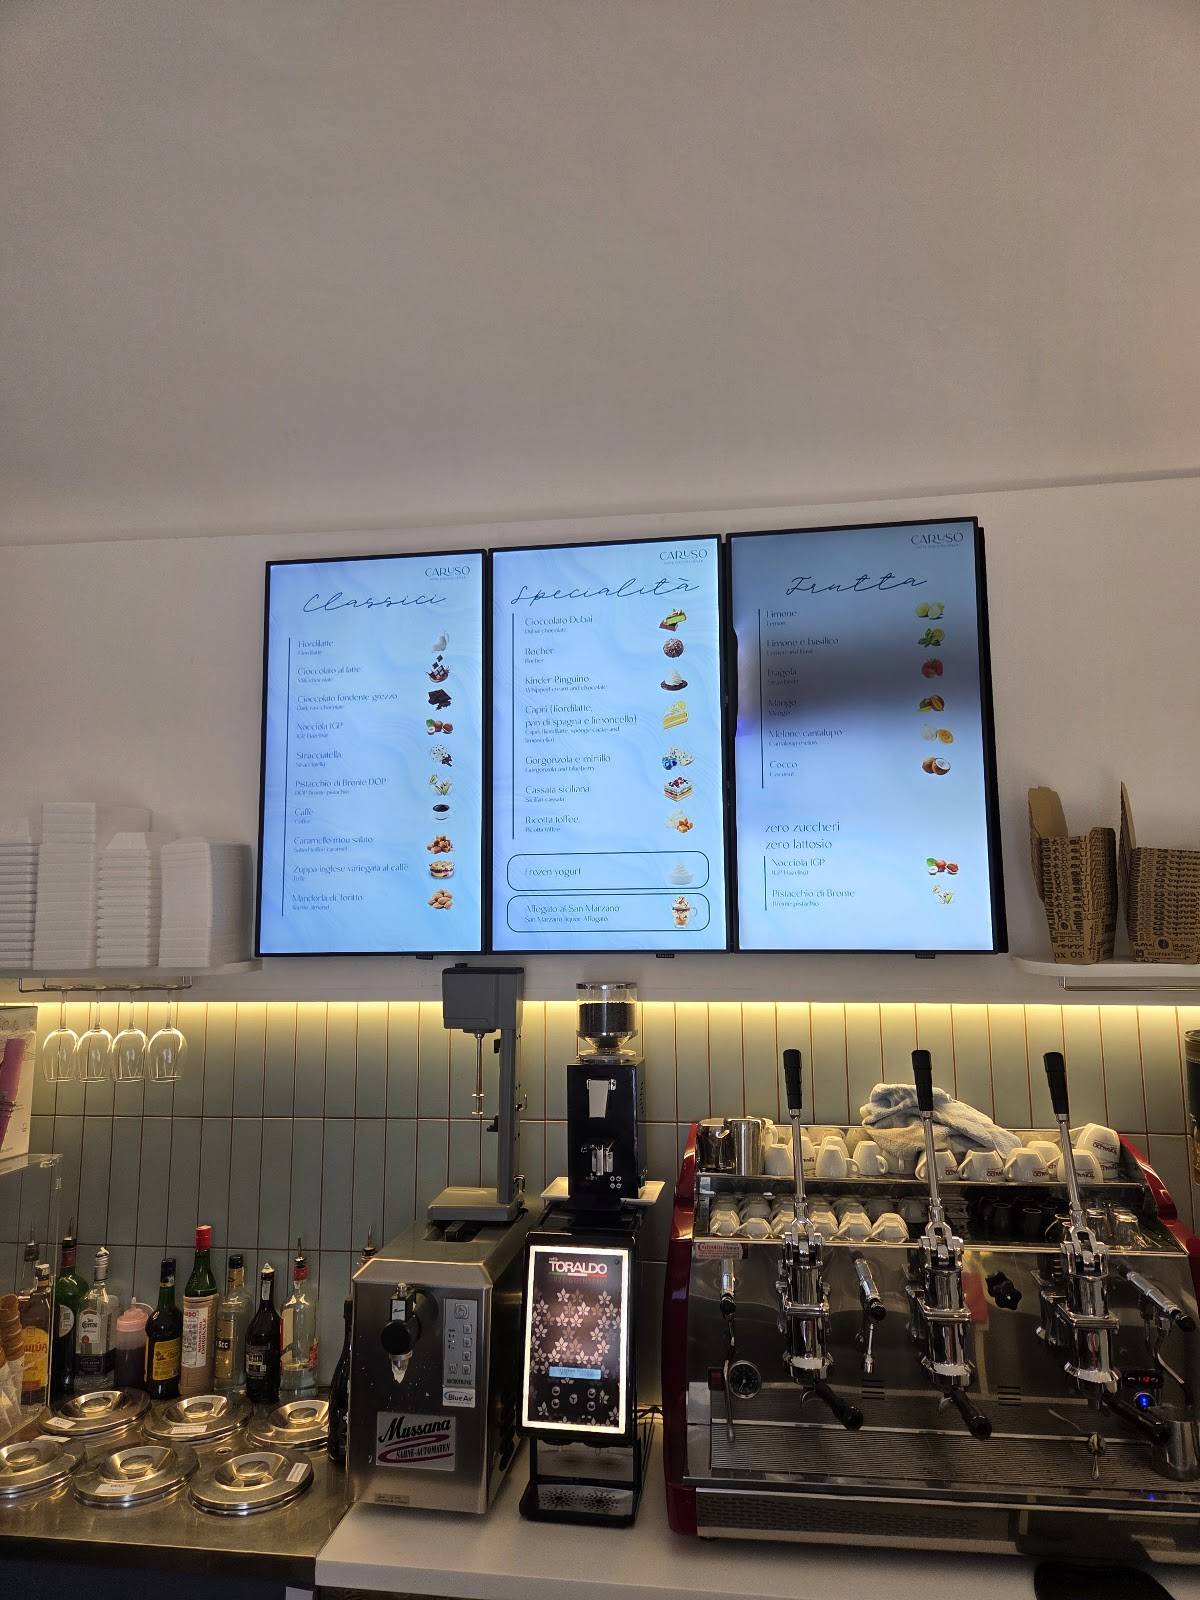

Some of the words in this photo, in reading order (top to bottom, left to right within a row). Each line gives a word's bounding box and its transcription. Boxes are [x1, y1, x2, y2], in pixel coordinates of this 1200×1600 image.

[911, 532, 963, 544] CARUSO
[660, 549, 707, 560] CARUSO
[425, 566, 470, 577] CARUSO
[786, 572, 927, 595] Frutta
[511, 578, 700, 606] Specialità
[303, 592, 447, 612] Classici
[766, 610, 797, 618] Limone
[524, 616, 567, 626] Cioccolato
[570, 615, 592, 624] Dubai
[767, 639, 798, 647] Limone
[808, 637, 839, 646] basilico
[525, 647, 554, 656] Rocher
[525, 676, 553, 684] Kinder
[554, 675, 589, 685] Pinguino
[298, 694, 335, 703] Cioccolato
[297, 722, 327, 730] Nocciola
[769, 729, 799, 738] Melone
[802, 728, 843, 739] cantalupo
[296, 750, 342, 759] Stracciatella
[525, 754, 573, 766] Gorgonzola
[770, 760, 798, 769] Cocco
[295, 778, 331, 788] Pistacchio
[525, 786, 556, 794] Cassata
[558, 785, 590, 793] siciliana
[525, 816, 553, 824] Ricotta
[765, 824, 789, 832] zero
[793, 821, 840, 832] zuccheri
[294, 836, 333, 845] Caramello
[766, 842, 789, 850] zero
[794, 838, 832, 849] lattosio
[770, 858, 808, 867] Nocciola
[810, 858, 826, 866] IGP
[319, 864, 345, 874] inglese
[773, 889, 813, 898] Pistacchio
[816, 889, 824, 897] di
[826, 889, 855, 897] Bronte
[569, 904, 583, 912] San
[585, 904, 620, 912] Marzano
[548, 1261, 608, 1275] TORALDO
[378, 1416, 450, 1442] Mussana
